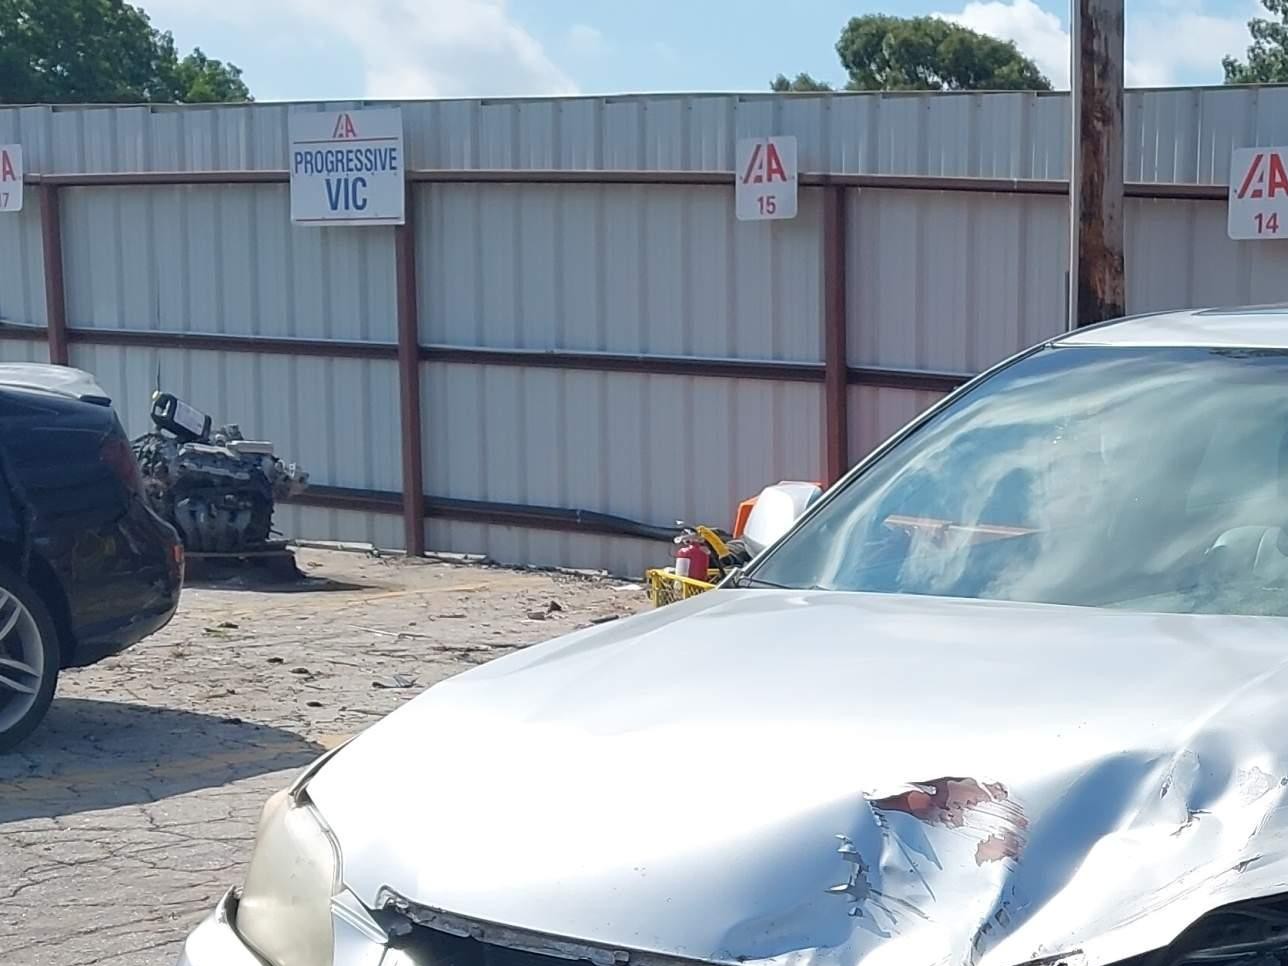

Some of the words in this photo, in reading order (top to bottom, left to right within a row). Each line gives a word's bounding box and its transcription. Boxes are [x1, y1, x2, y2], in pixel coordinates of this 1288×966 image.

[294, 147, 397, 174] PROGRESSIVE
[325, 176, 367, 211] VIC
[757, 195, 776, 215] 15
[1254, 212, 1279, 234] 14
